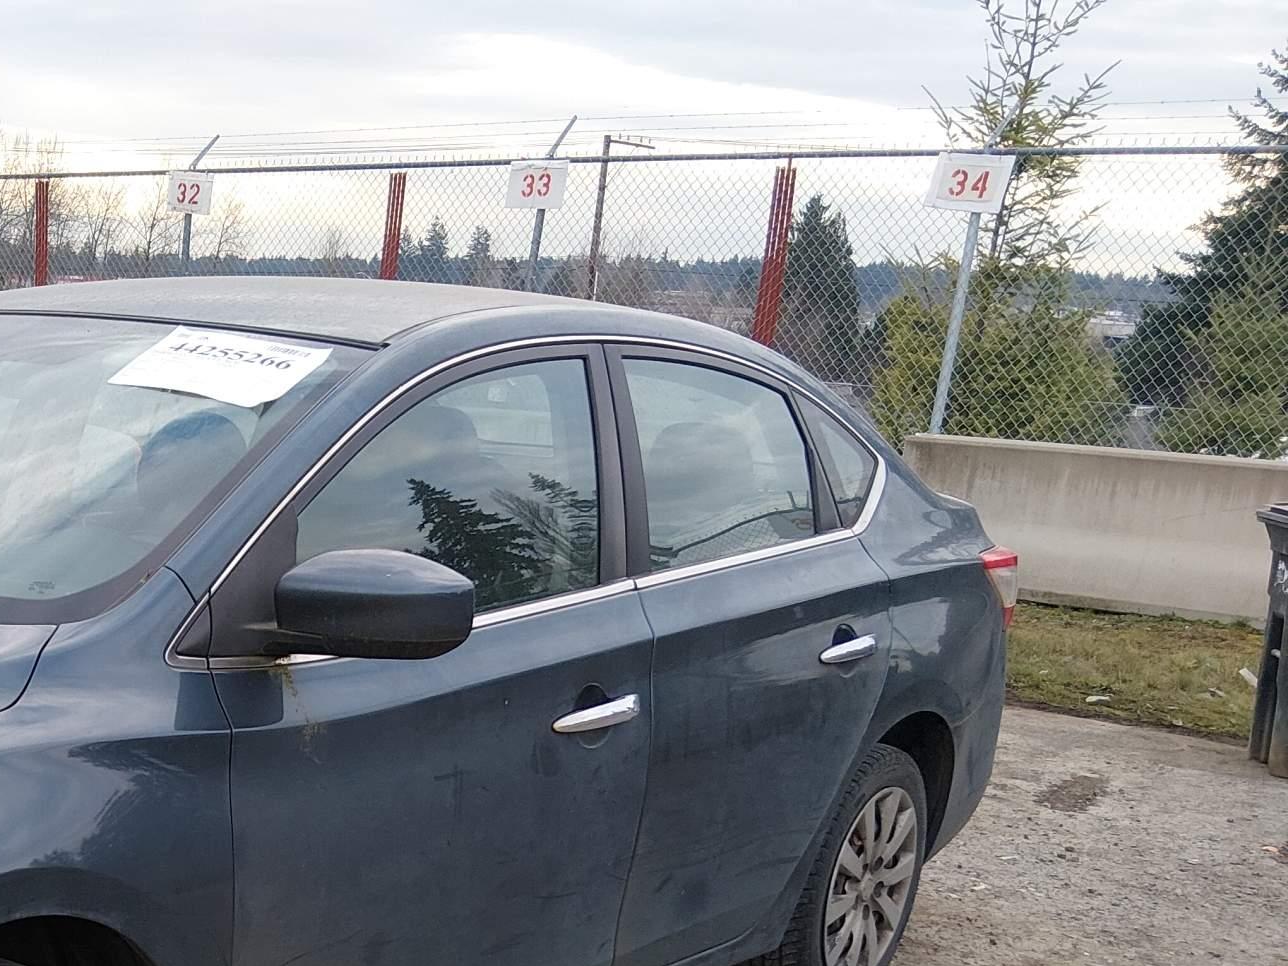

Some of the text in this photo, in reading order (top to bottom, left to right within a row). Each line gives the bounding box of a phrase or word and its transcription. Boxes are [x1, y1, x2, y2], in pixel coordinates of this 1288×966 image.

[176, 182, 201, 205] 32
[521, 173, 552, 198] 33
[948, 168, 991, 199] 34
[169, 342, 292, 370] 44255266
